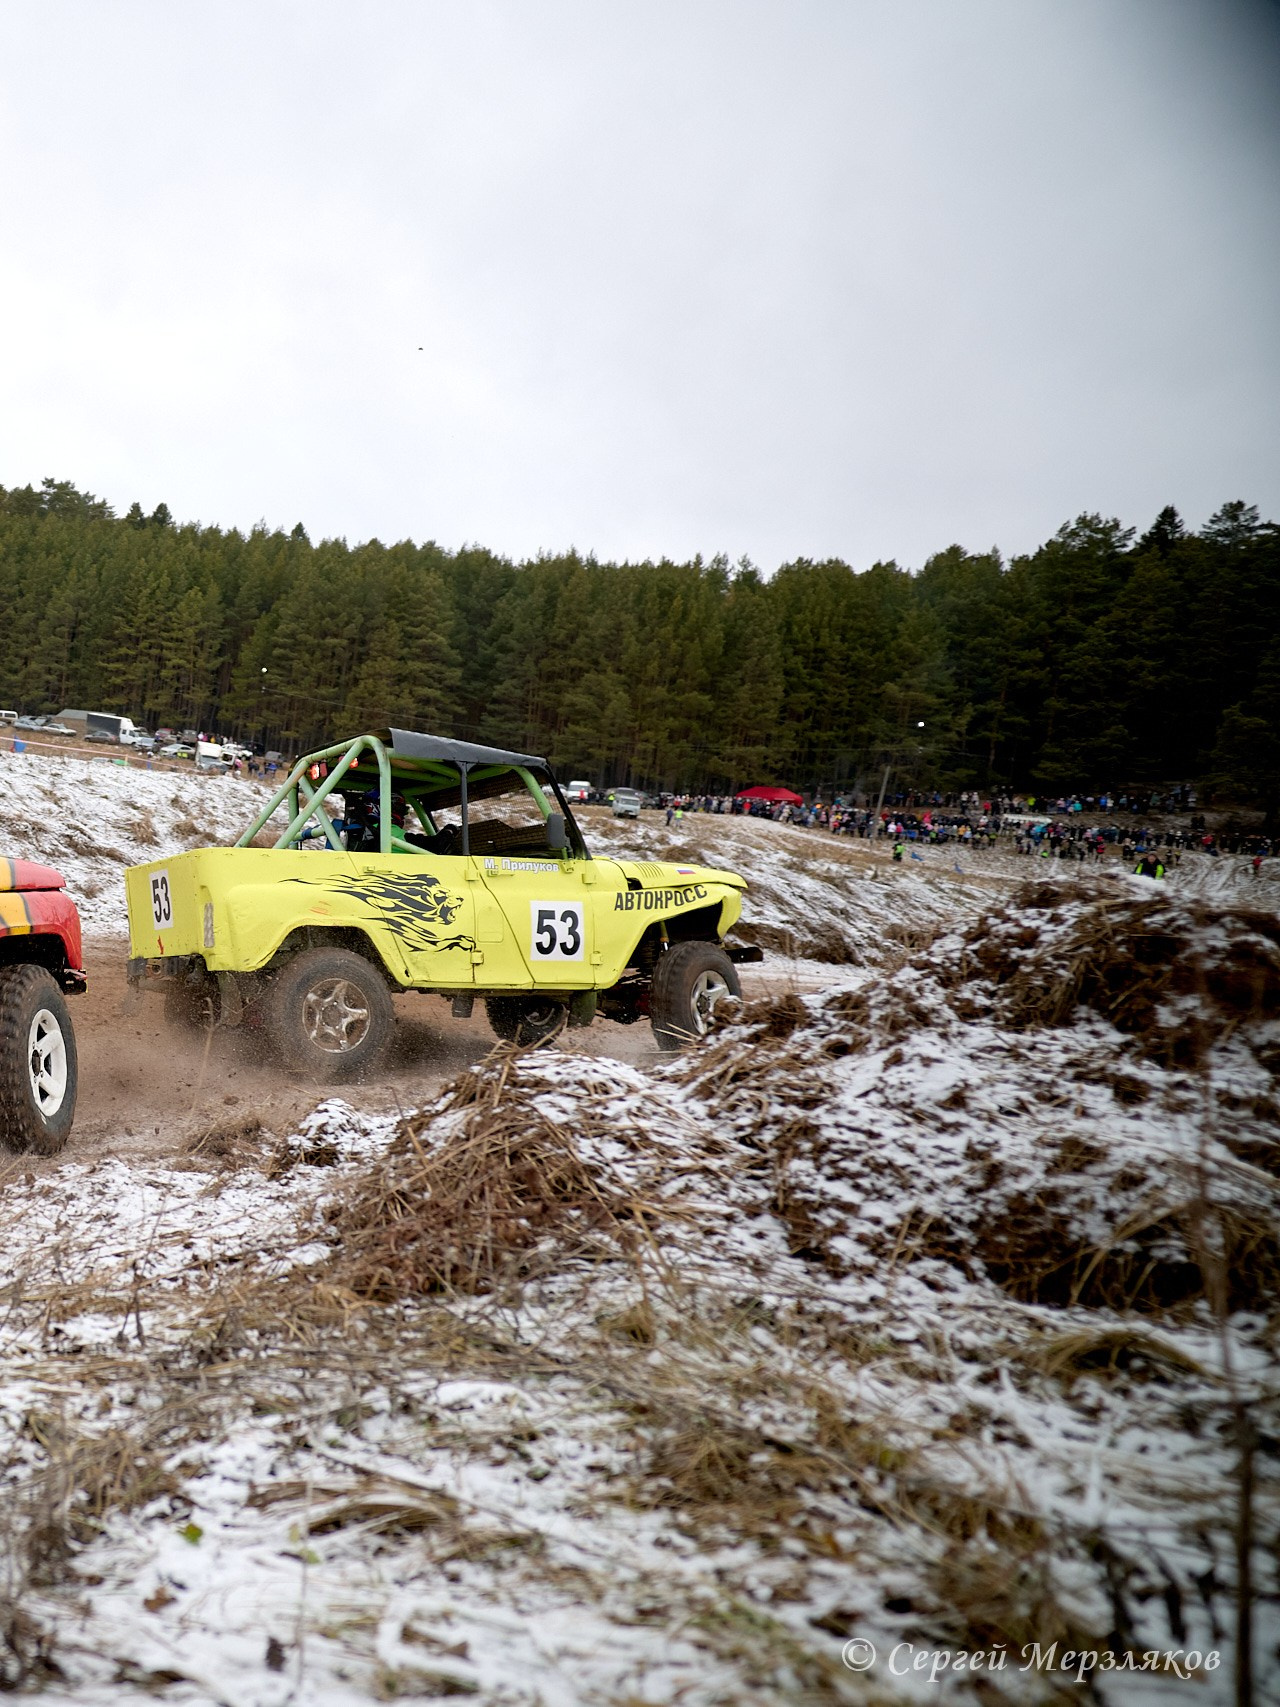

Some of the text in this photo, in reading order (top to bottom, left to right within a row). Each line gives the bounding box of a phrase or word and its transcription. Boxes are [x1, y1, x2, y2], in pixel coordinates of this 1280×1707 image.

[484, 858, 559, 874] М. Прилуков
[152, 876, 170, 922] 53
[614, 884, 707, 911] АВТОКРОСС
[535, 909, 581, 956] 53
